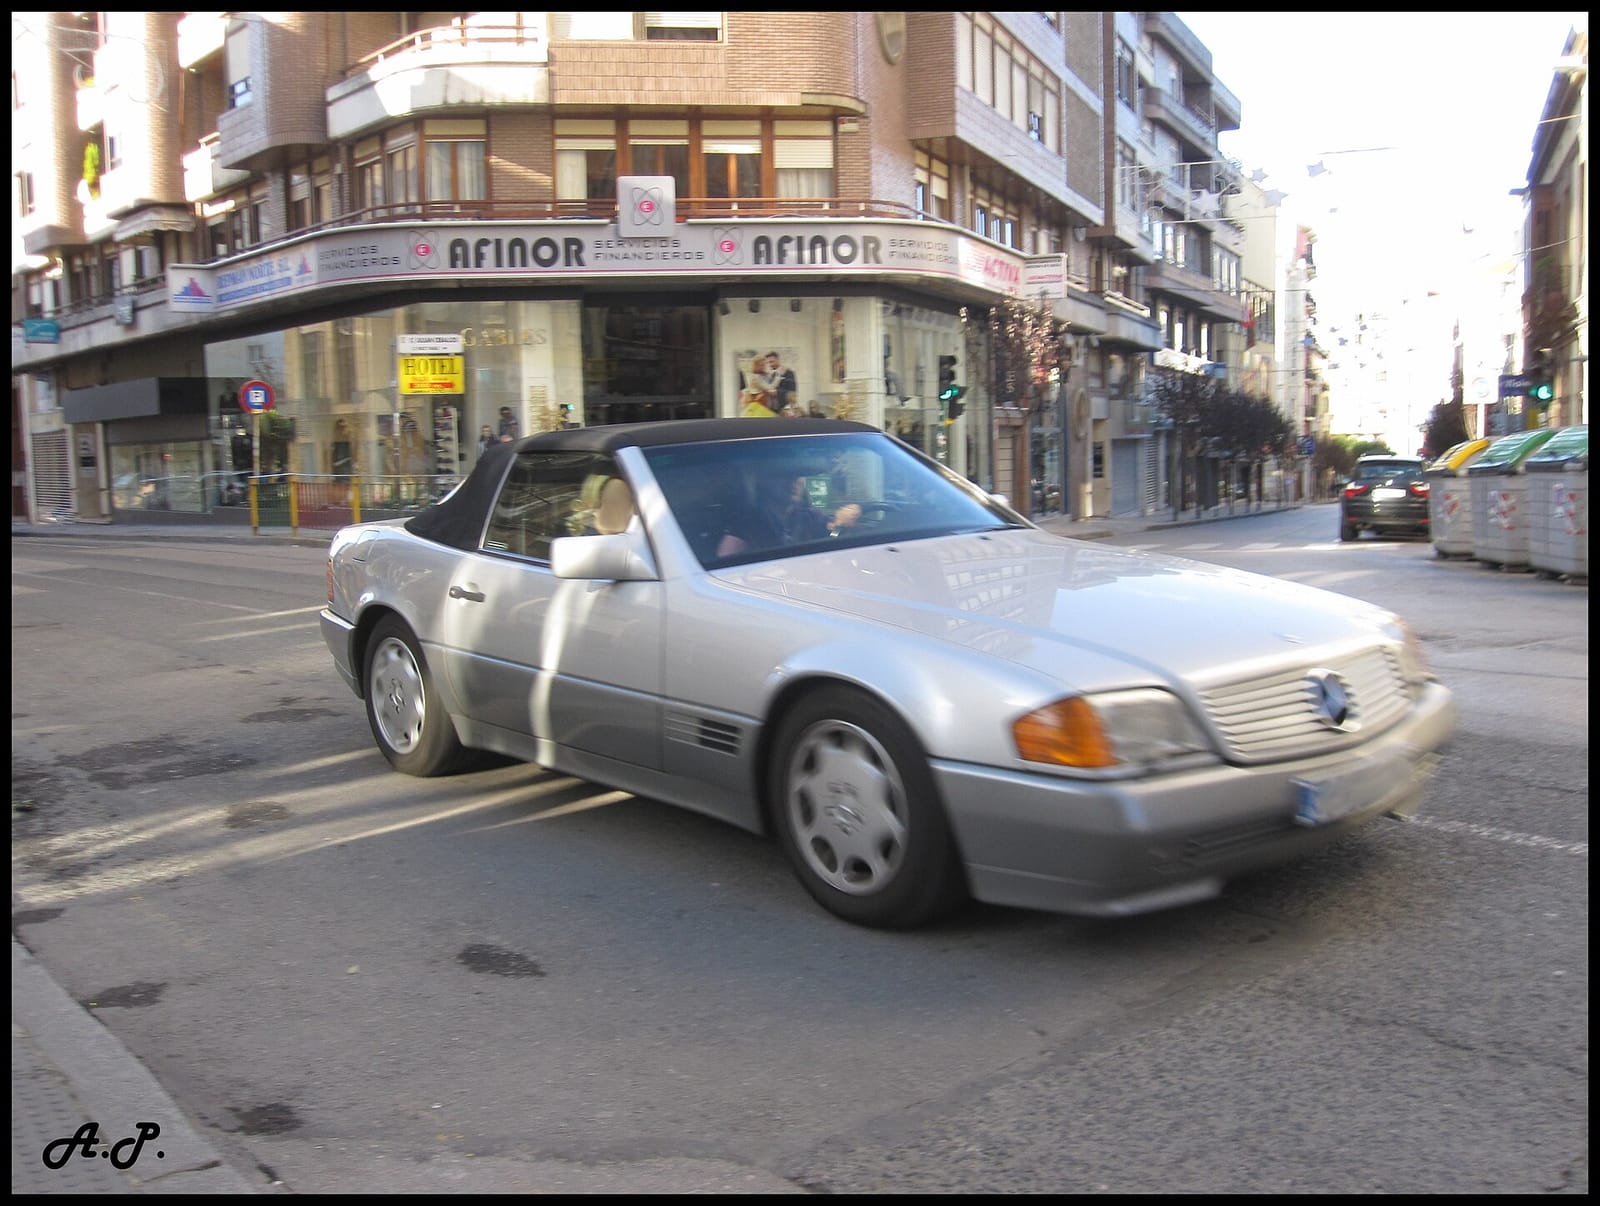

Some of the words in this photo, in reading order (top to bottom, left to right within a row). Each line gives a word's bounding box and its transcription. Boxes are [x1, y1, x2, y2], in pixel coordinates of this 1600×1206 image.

[449, 237, 586, 268] AFINOR
[594, 240, 681, 249] SERVICIOS
[753, 234, 882, 265] AFINOR
[889, 238, 949, 251] SERVICIOS
[318, 245, 378, 261] SERVICIOS
[594, 251, 705, 261] FINANCIEROS
[318, 256, 400, 272] FINANCIEROS
[403, 358, 459, 375] HOTEL
